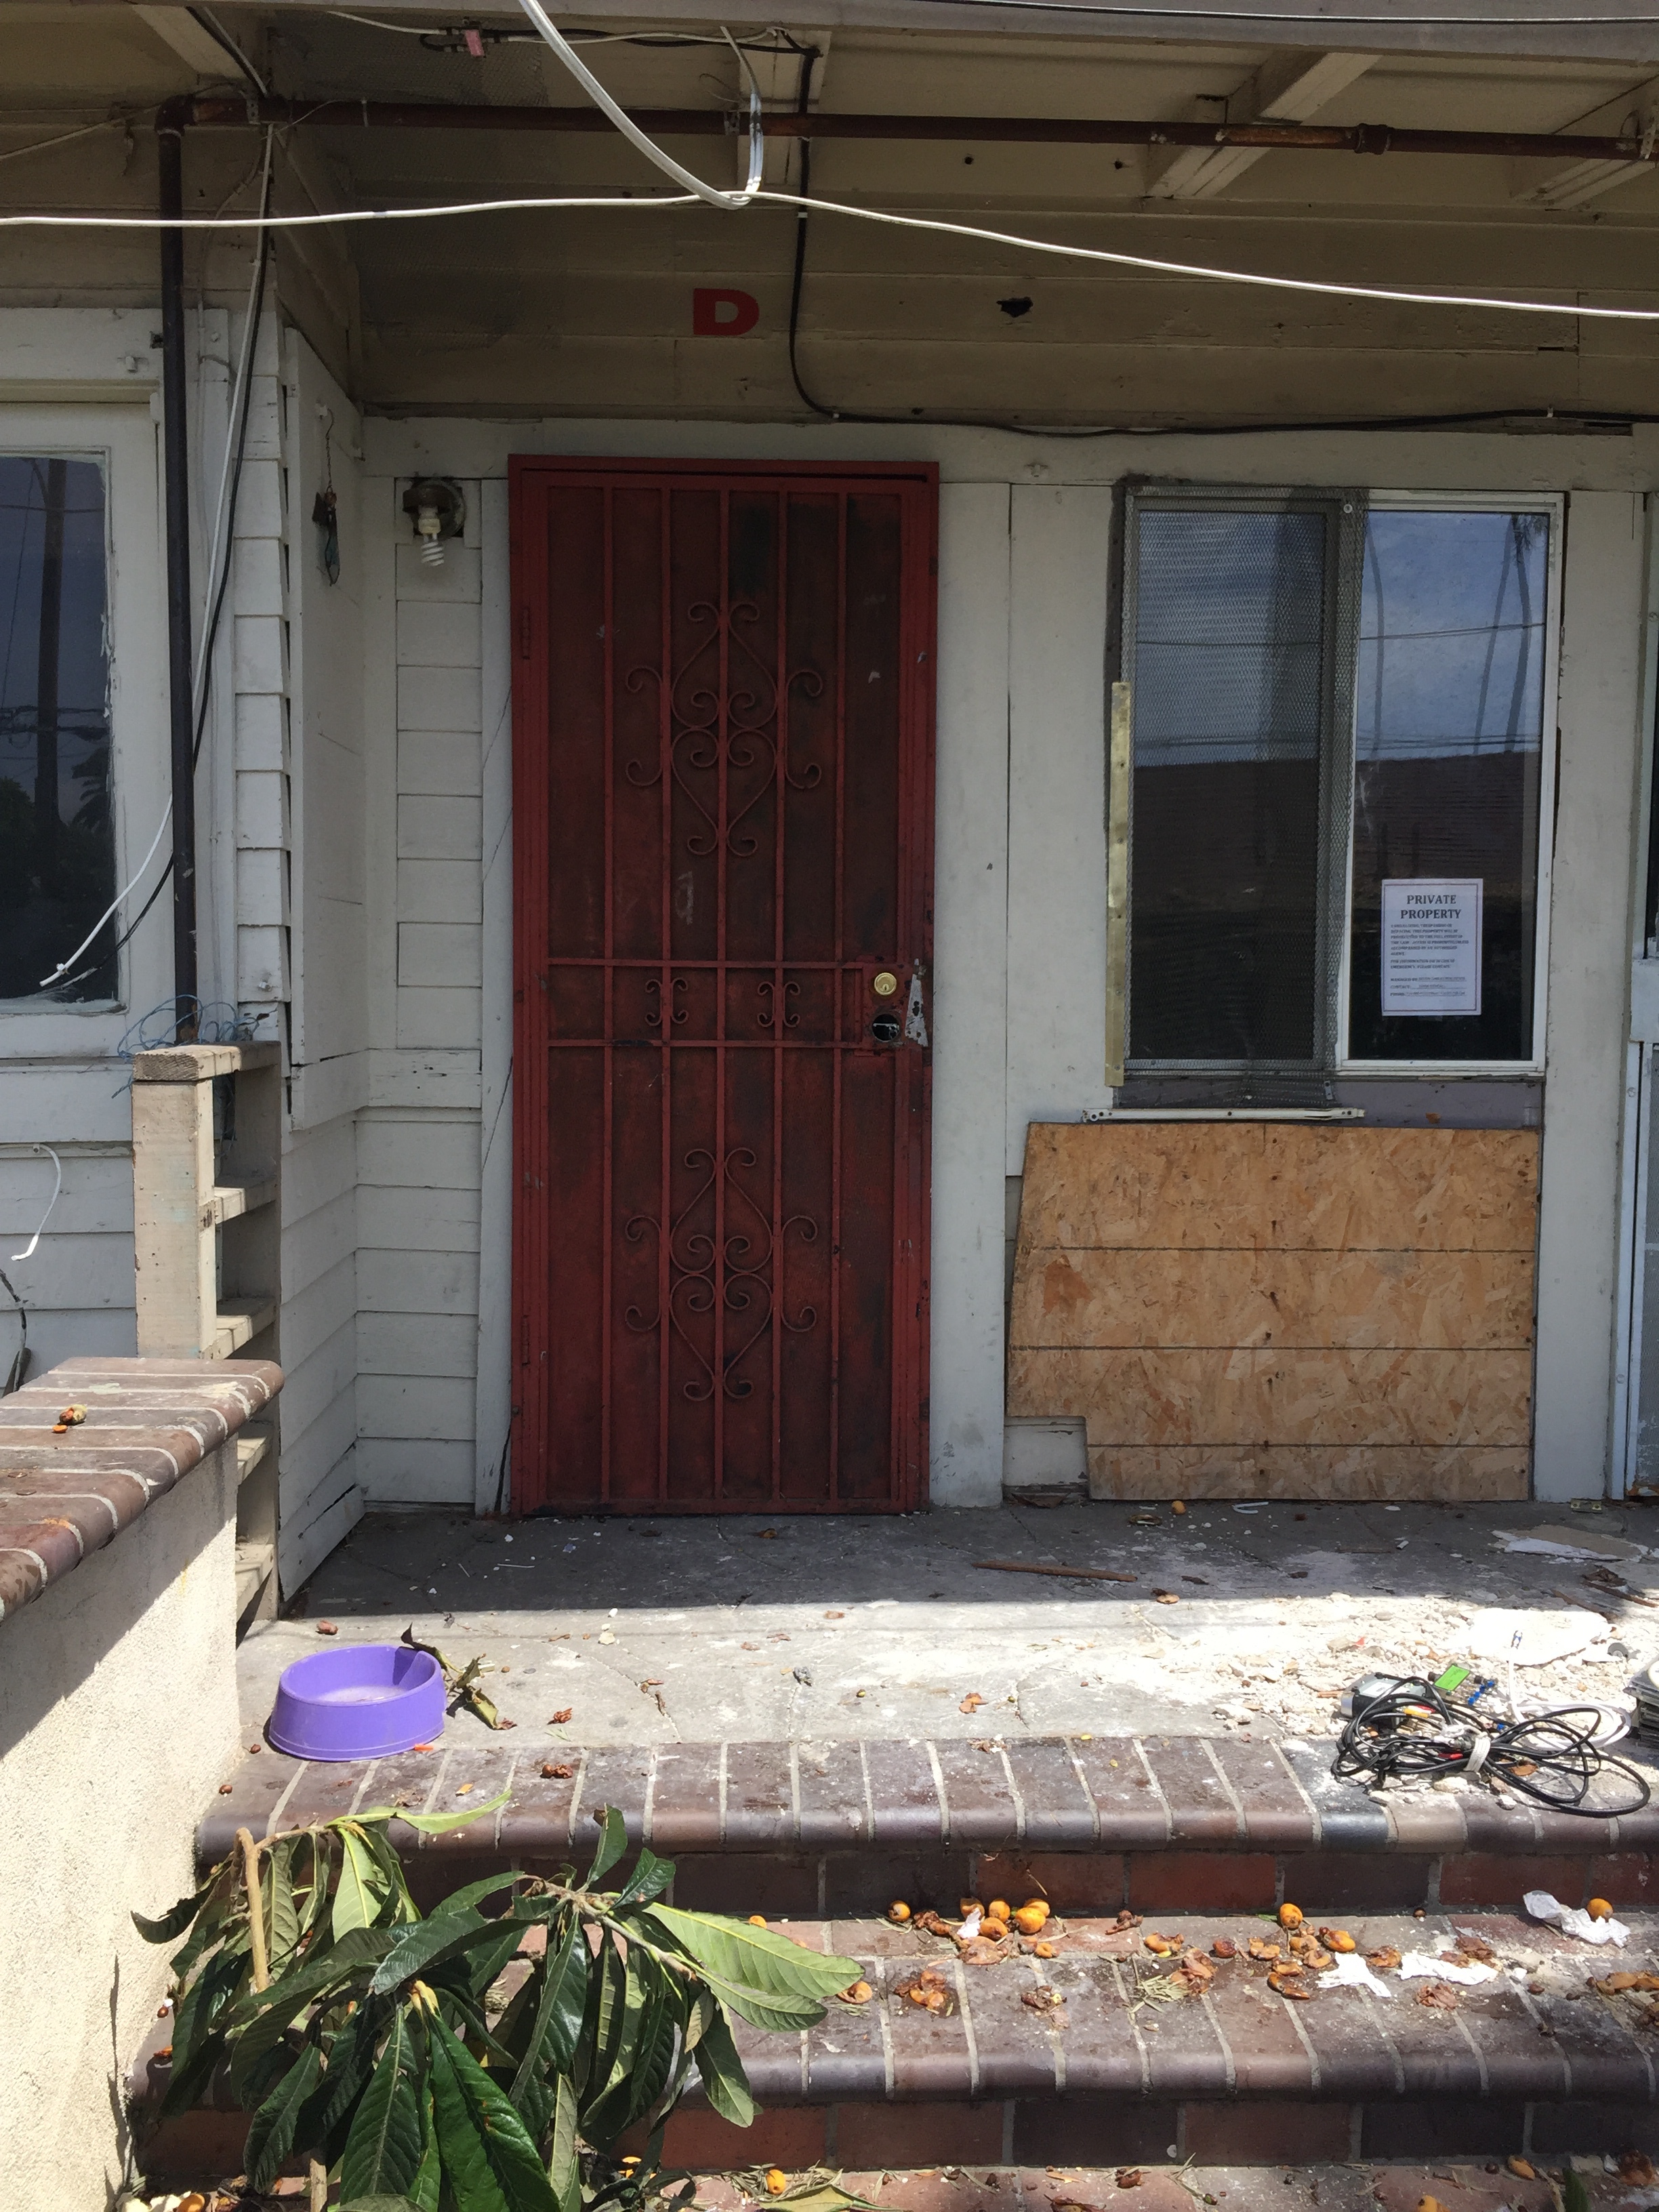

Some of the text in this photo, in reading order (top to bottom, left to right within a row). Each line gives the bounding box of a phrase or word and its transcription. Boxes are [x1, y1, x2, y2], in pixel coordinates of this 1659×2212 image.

[693, 288, 760, 336] D
[1406, 895, 1457, 905] PRIVATE
[1400, 909, 1462, 920] PROPERTY
